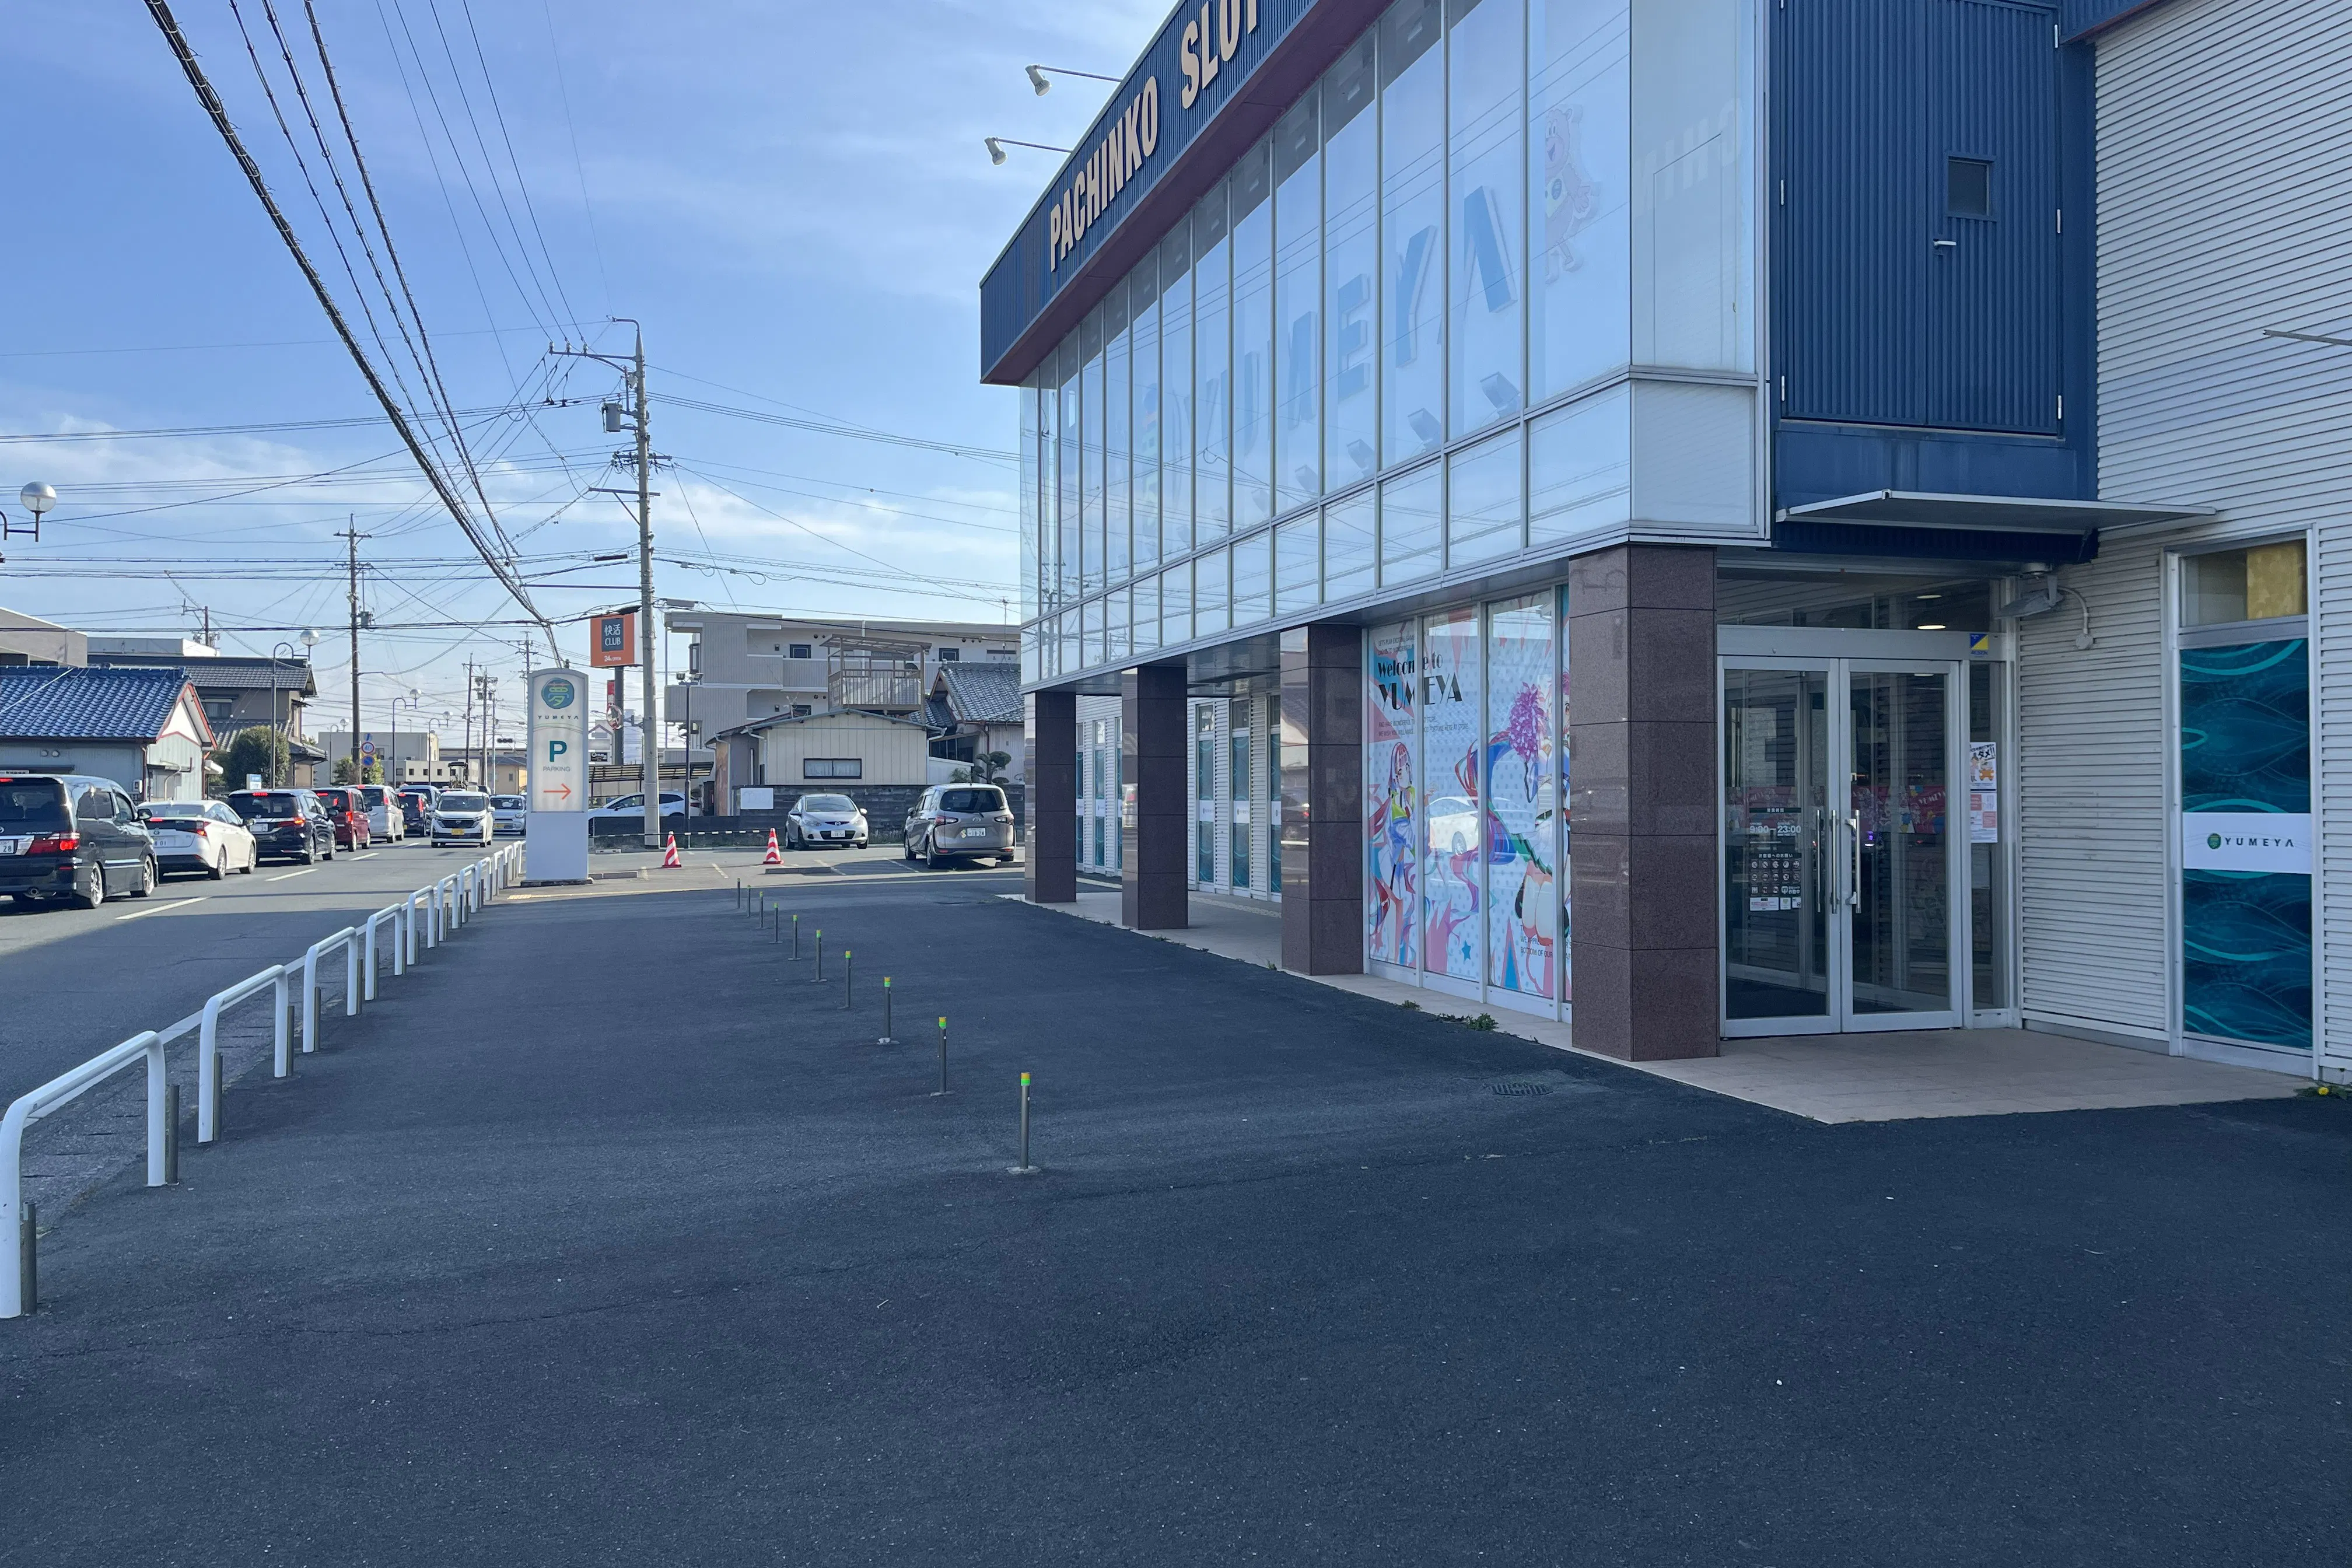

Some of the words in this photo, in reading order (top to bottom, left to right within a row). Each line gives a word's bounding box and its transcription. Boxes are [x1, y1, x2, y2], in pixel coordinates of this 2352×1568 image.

[1050, 76, 1158, 273] PACHINKO
[604, 624, 621, 636] 快活
[604, 637, 621, 646] CLUB
[1432, 651, 1443, 669] to
[549, 740, 568, 762] P
[1777, 825, 1801, 834] 23:00
[2224, 837, 2295, 847] YUMEYA
[1520, 947, 1537, 956] BOTTOM
